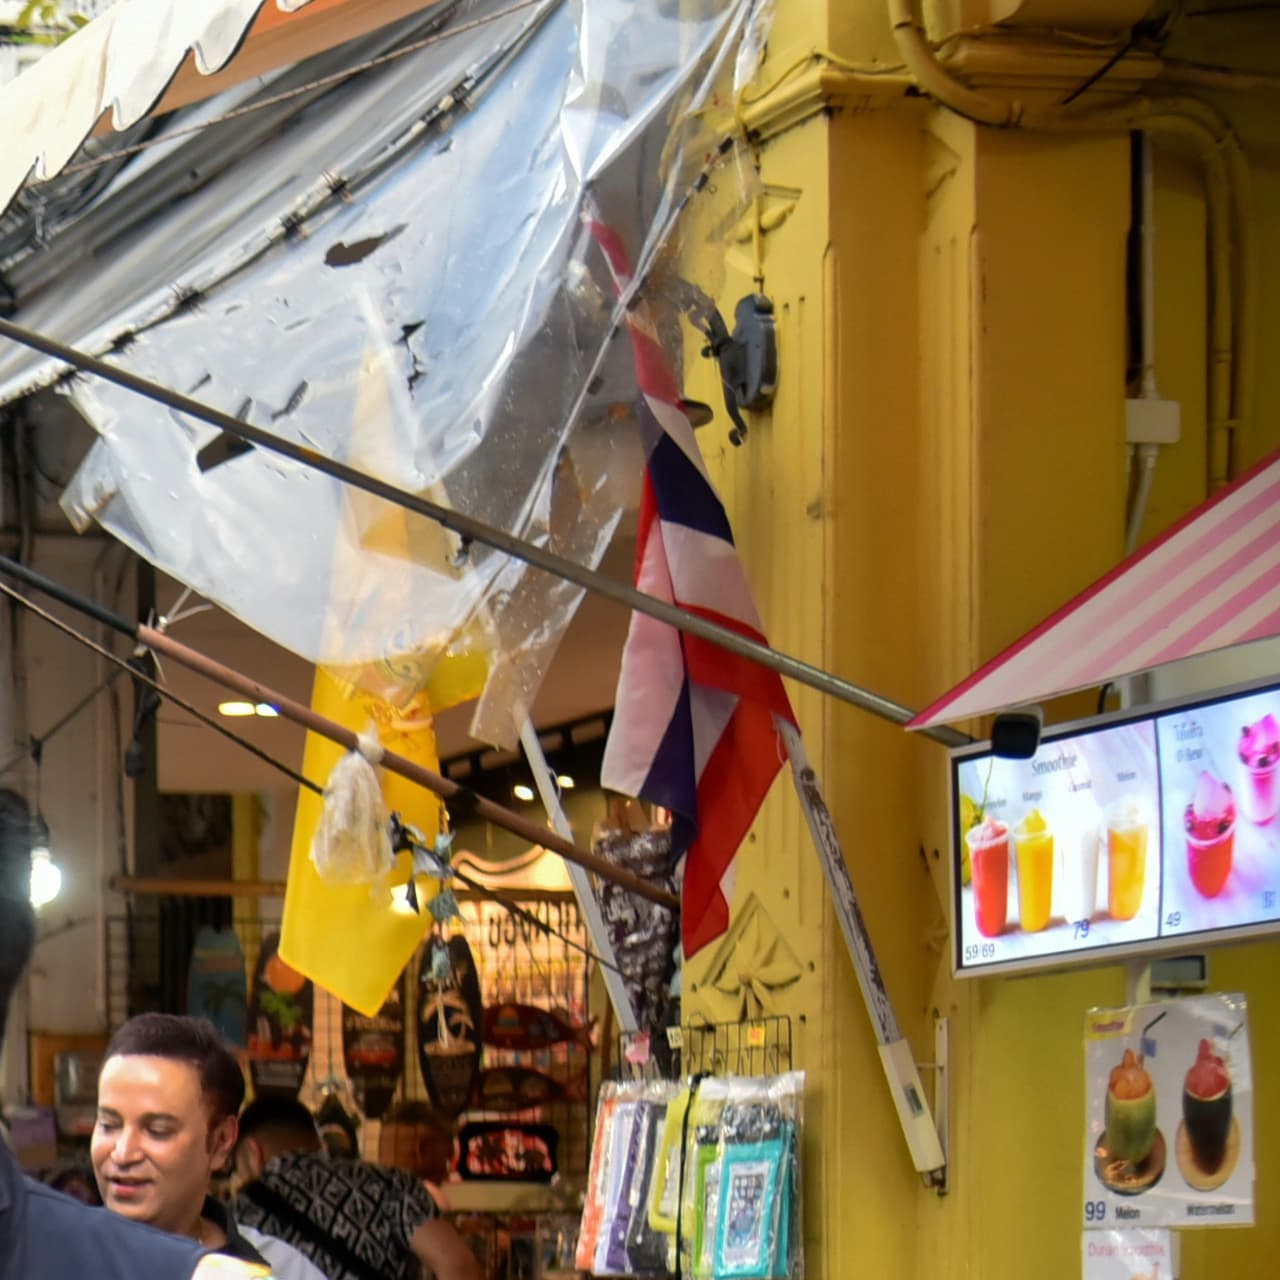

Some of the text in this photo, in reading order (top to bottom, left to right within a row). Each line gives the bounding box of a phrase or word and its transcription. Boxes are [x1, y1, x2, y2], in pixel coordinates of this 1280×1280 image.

[1031, 753, 1078, 776] Smoothie
[1072, 918, 1091, 941] 79
[1085, 1201, 1106, 1221] 99
[1115, 1206, 1141, 1220] Melon
